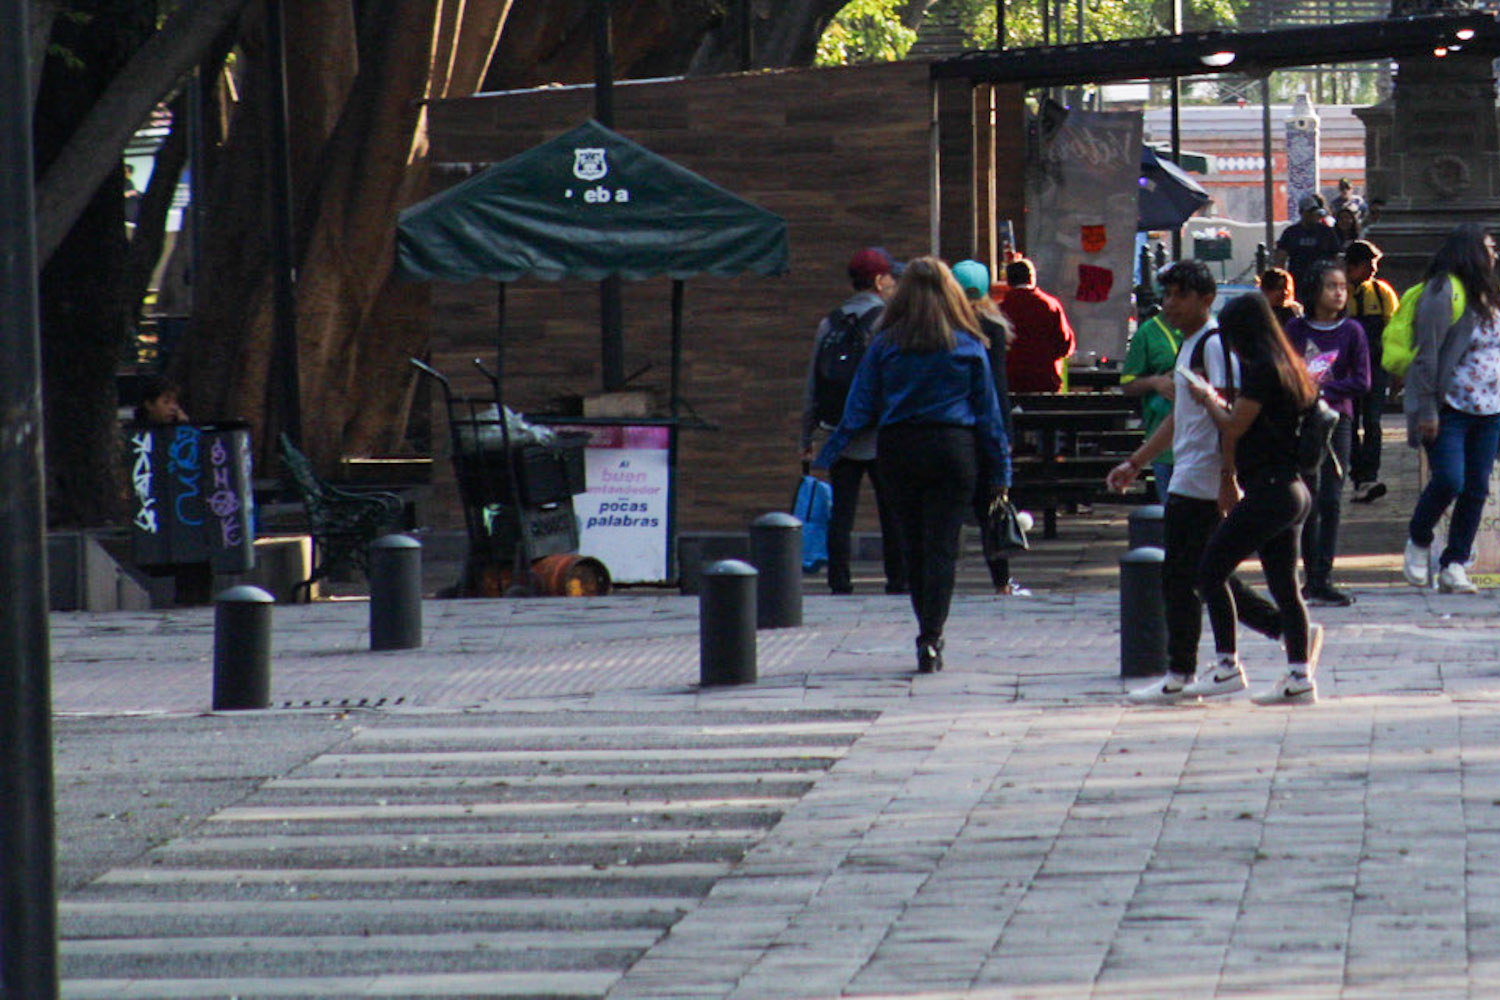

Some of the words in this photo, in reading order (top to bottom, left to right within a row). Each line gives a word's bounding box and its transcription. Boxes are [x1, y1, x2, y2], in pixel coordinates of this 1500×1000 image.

[601, 468, 648, 482] buen
[599, 502, 648, 514] pocas
[587, 515, 659, 529] palabras
